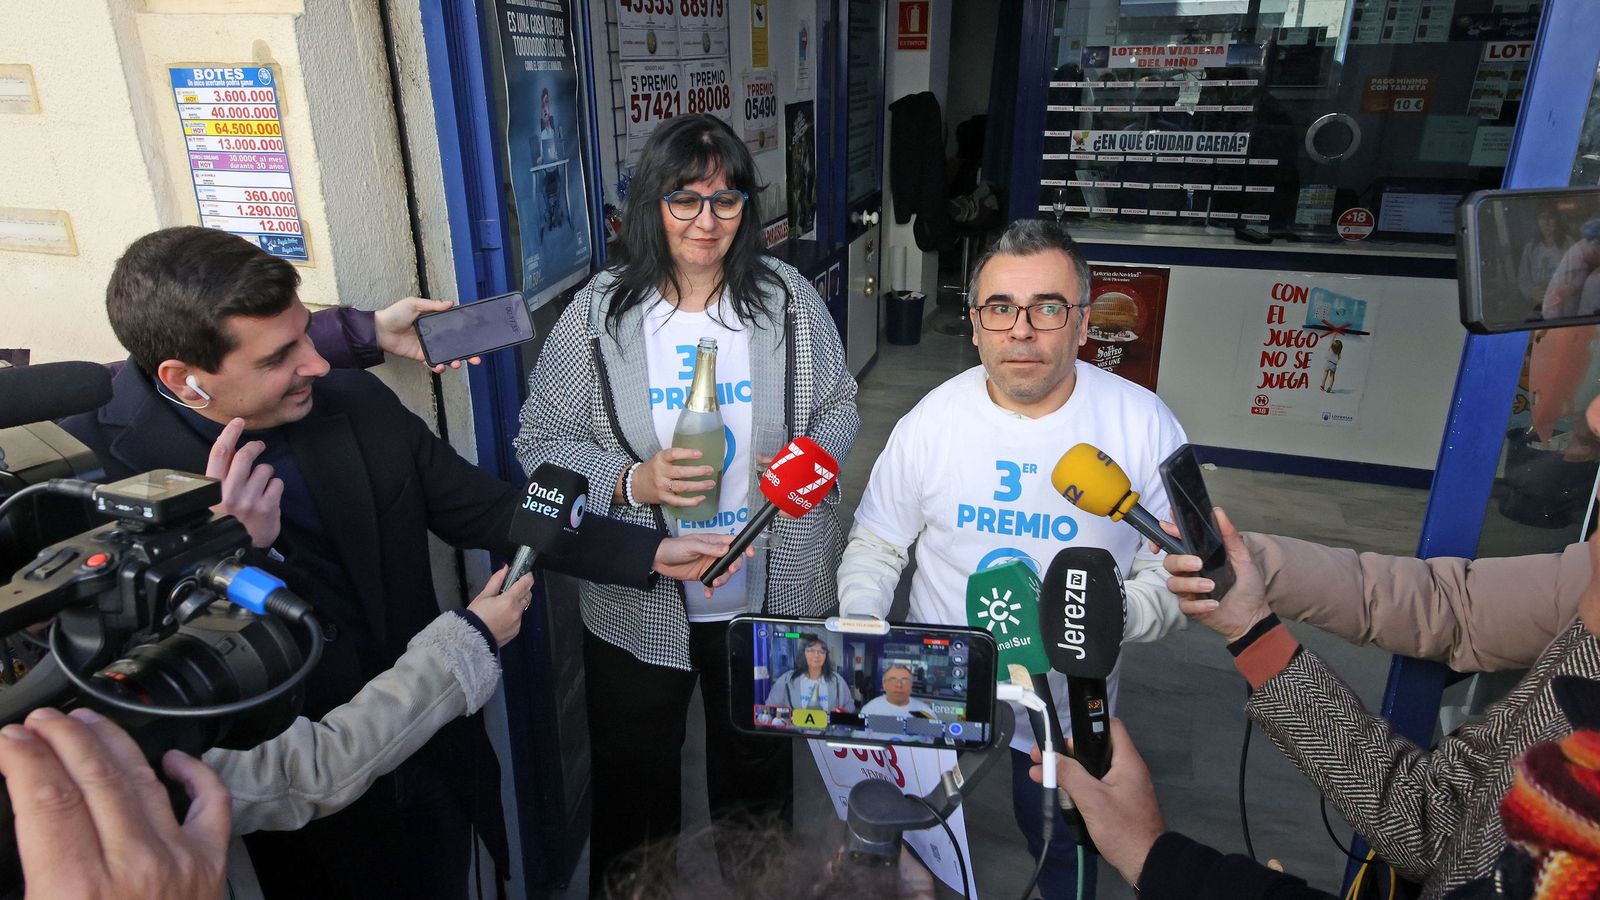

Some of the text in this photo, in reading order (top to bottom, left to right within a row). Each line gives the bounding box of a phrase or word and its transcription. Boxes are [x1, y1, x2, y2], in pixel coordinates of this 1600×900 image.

[506, 11, 516, 32] ES
[516, 12, 530, 33] UNA
[530, 14, 545, 34] COSA
[545, 16, 554, 36] QUE
[1111, 45, 1225, 57] LOTERÍA VIAJERA
[1138, 57, 1198, 67] DEL NIÑO
[192, 68, 245, 80] BOTES
[696, 69, 725, 87] PREMIO
[641, 74, 678, 92] PREMIO
[752, 82, 774, 96] PREMIO
[213, 90, 274, 103] 3.600.000
[688, 84, 730, 114] 88008
[1395, 100, 1423, 109] 10 €
[211, 106, 277, 119] 40.000.000
[630, 91, 682, 123] 57421
[745, 96, 776, 120] 05490
[215, 123, 280, 135] 64.500.000
[218, 139, 283, 151] 13.000.000
[1093, 132, 1247, 152] ¿EN QUÉ CIUDAD CAERÁ?
[259, 155, 267, 163] al
[244, 190, 294, 202] 360.000
[237, 205, 297, 218] 1.290.000
[1347, 211, 1366, 223] +18
[259, 220, 300, 233] 12.000
[1271, 283, 1309, 304] CON
[1266, 304, 1287, 324] EL
[1264, 328, 1318, 348] JUEGO
[1096, 346, 1123, 359] SORTEO
[1260, 350, 1313, 369] NO SE
[1108, 358, 1121, 366] UNE
[1257, 371, 1309, 389] JUEGA
[763, 469, 781, 487] siete
[528, 482, 565, 504] Onda
[787, 491, 813, 510] siete
[522, 495, 560, 518] Jerez
[957, 504, 1078, 541] PREMIO
[1058, 574, 1086, 660] Jerez TV
[931, 703, 955, 715] Jerez
[804, 713, 816, 725] A
